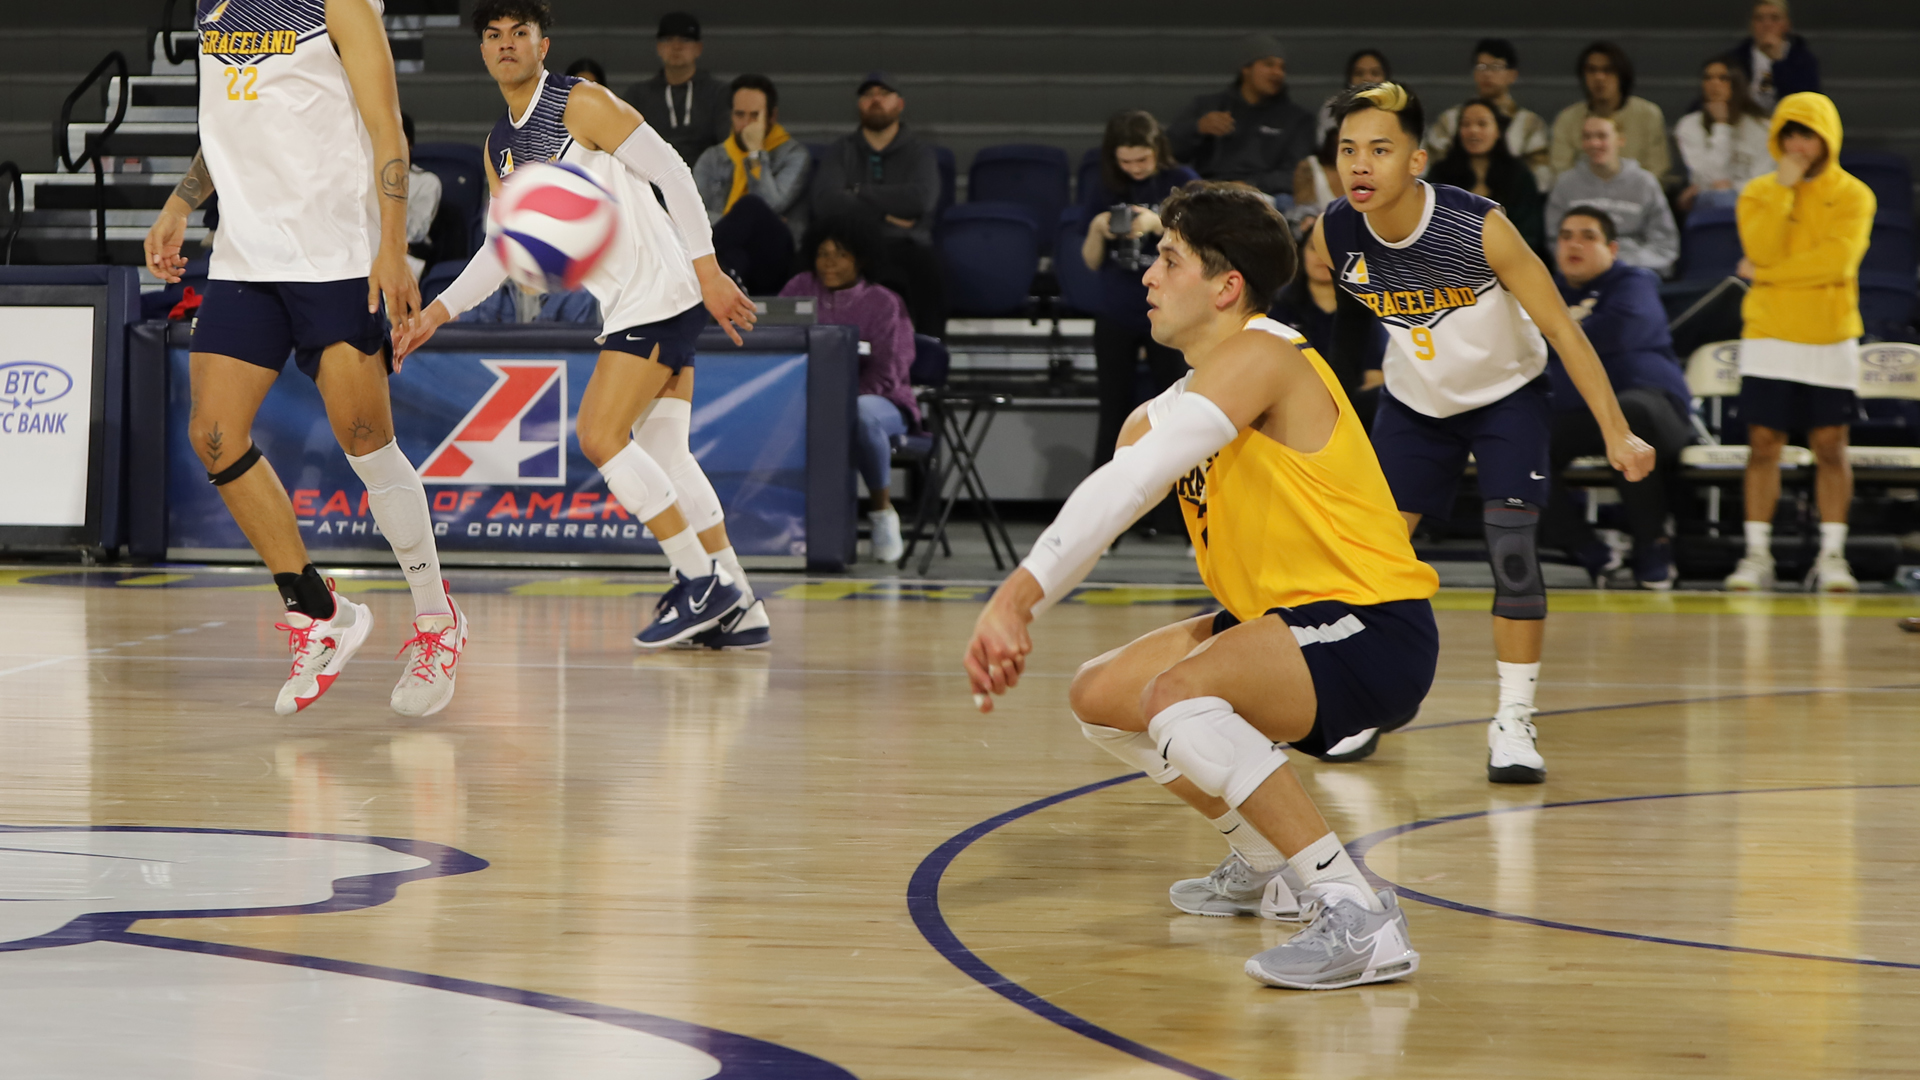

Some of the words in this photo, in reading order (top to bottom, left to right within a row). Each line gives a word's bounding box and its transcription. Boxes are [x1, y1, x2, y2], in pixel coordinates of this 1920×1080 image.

[202, 30, 298, 55] GRACELAND
[223, 66, 258, 101] 22
[1411, 327, 1436, 360] 9
[4, 370, 49, 395] BTC
[17, 412, 69, 434] BANK
[433, 491, 482, 512] OF
[486, 491, 630, 520] AMER
[467, 522, 656, 539] CONFERENCE
